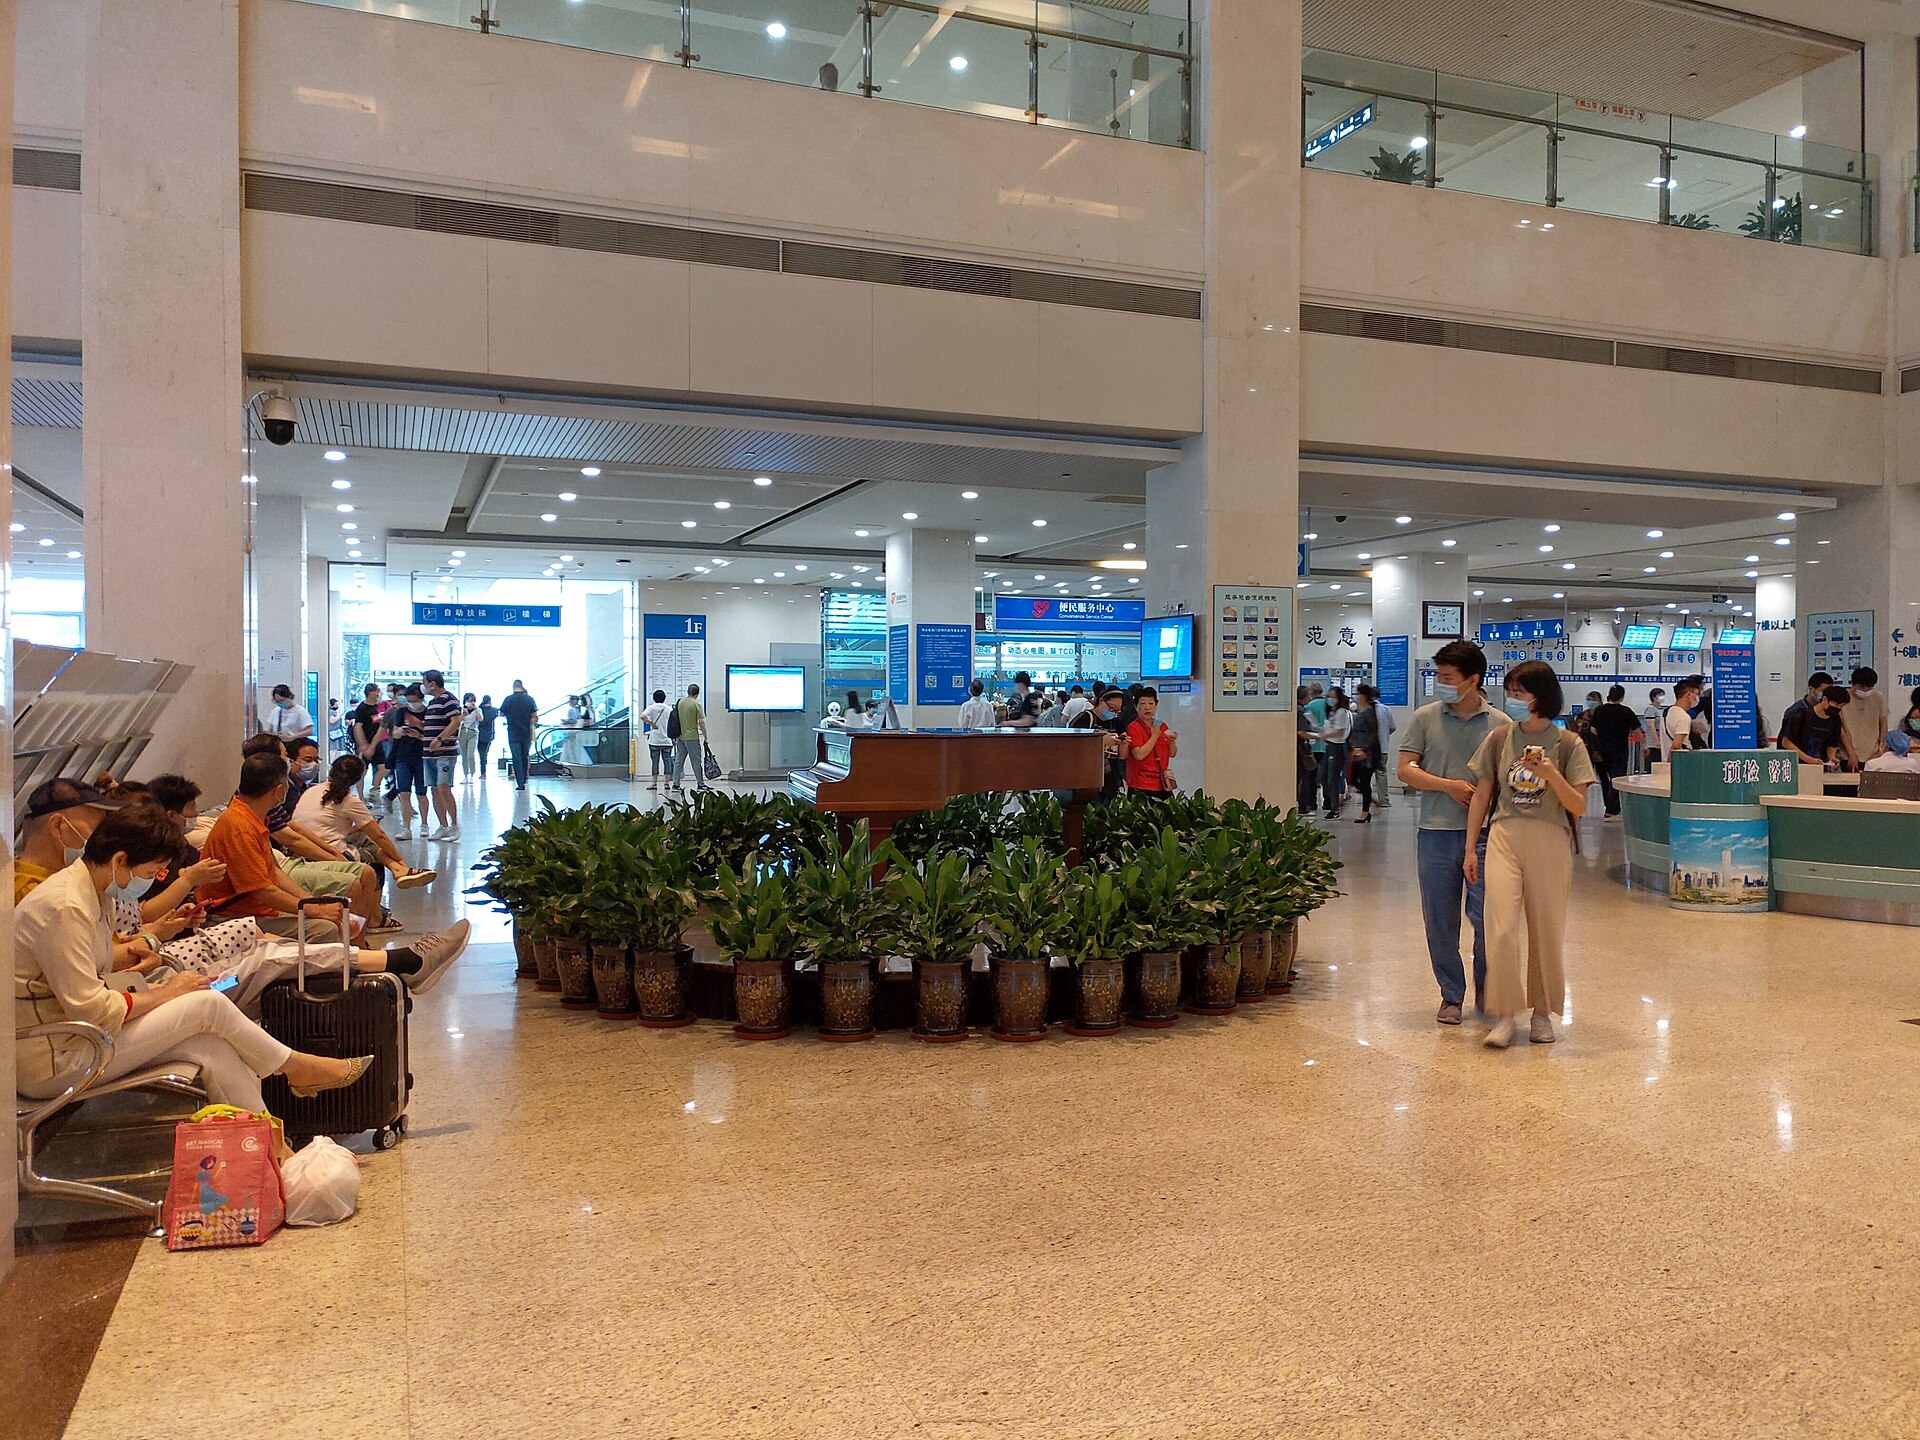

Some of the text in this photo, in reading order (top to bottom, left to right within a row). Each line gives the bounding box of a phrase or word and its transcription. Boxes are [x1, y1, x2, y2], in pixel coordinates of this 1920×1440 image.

[444, 608, 551, 618] 自动扶梯 楼梯
[1059, 601, 1115, 613] 便民服务中心
[684, 617, 703, 634] 1F
[1723, 759, 1792, 783] 预检 咨询
